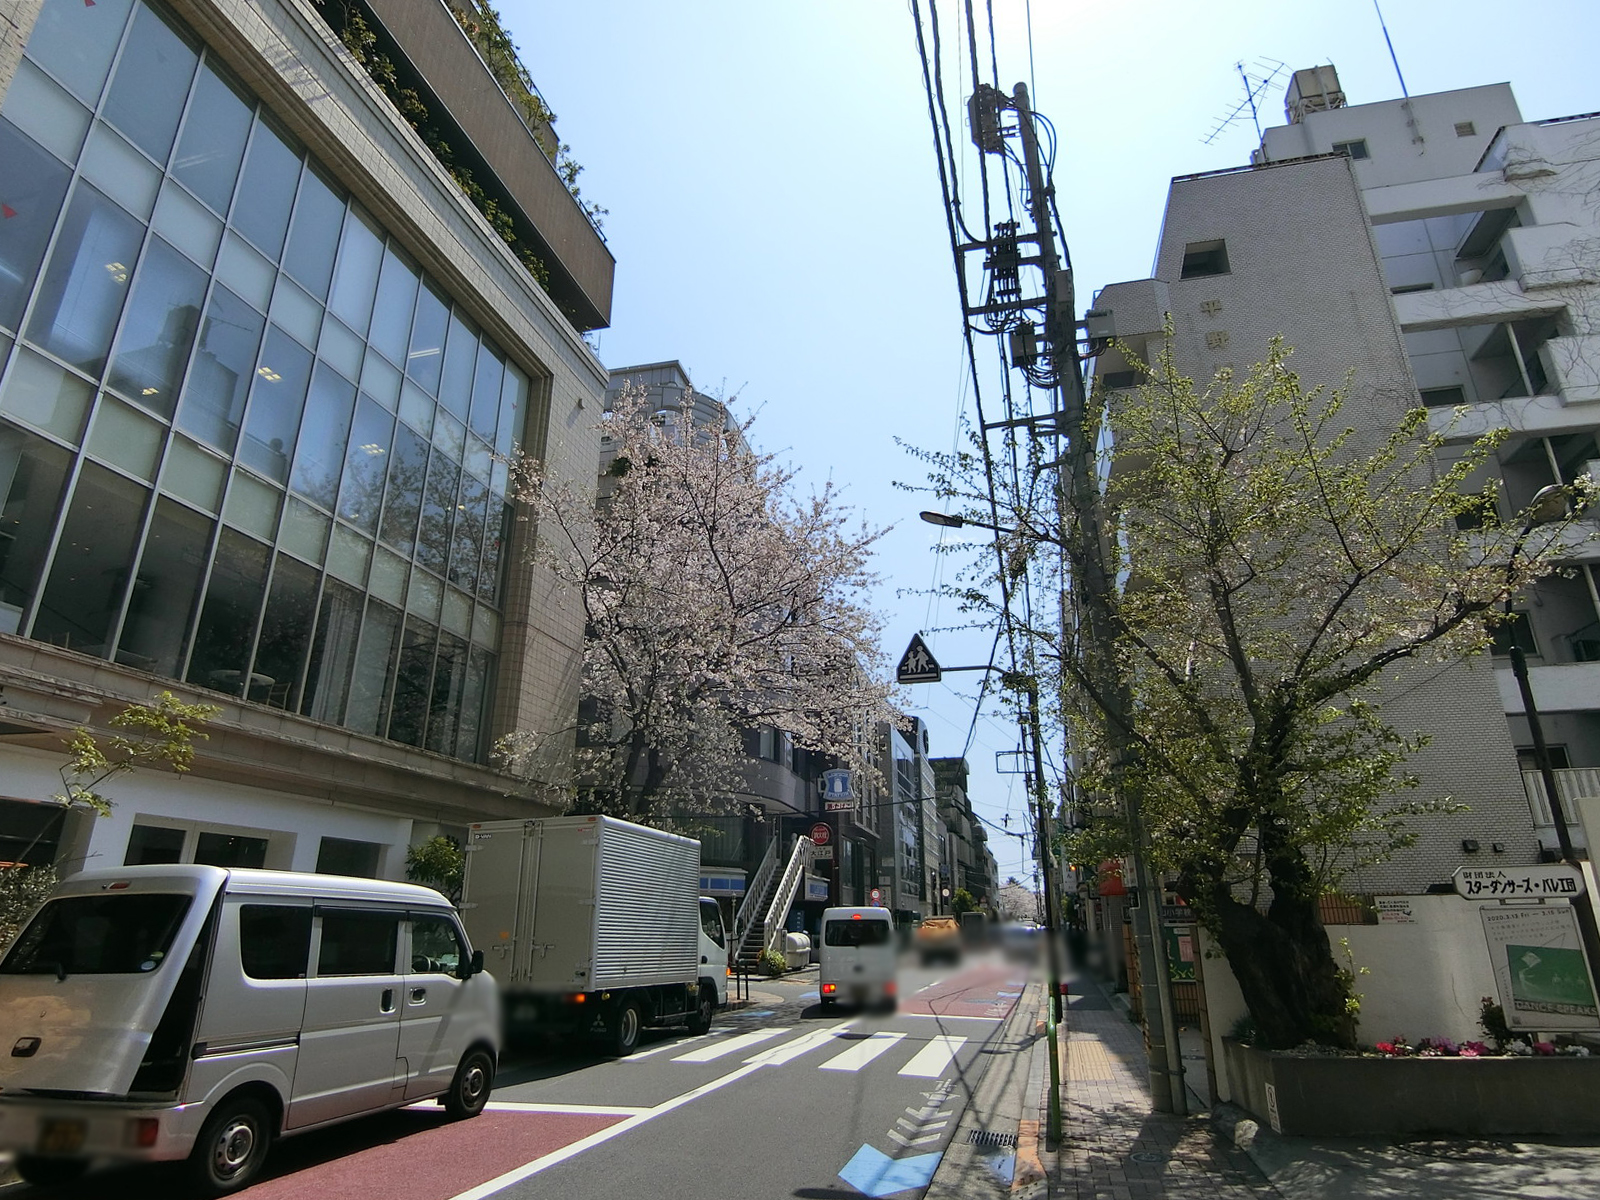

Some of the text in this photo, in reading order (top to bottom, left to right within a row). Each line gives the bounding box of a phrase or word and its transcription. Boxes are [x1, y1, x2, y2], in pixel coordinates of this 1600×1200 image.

[1462, 870, 1507, 879] 財団法人
[1516, 1000, 1598, 1016] DANCE SPEAKS
